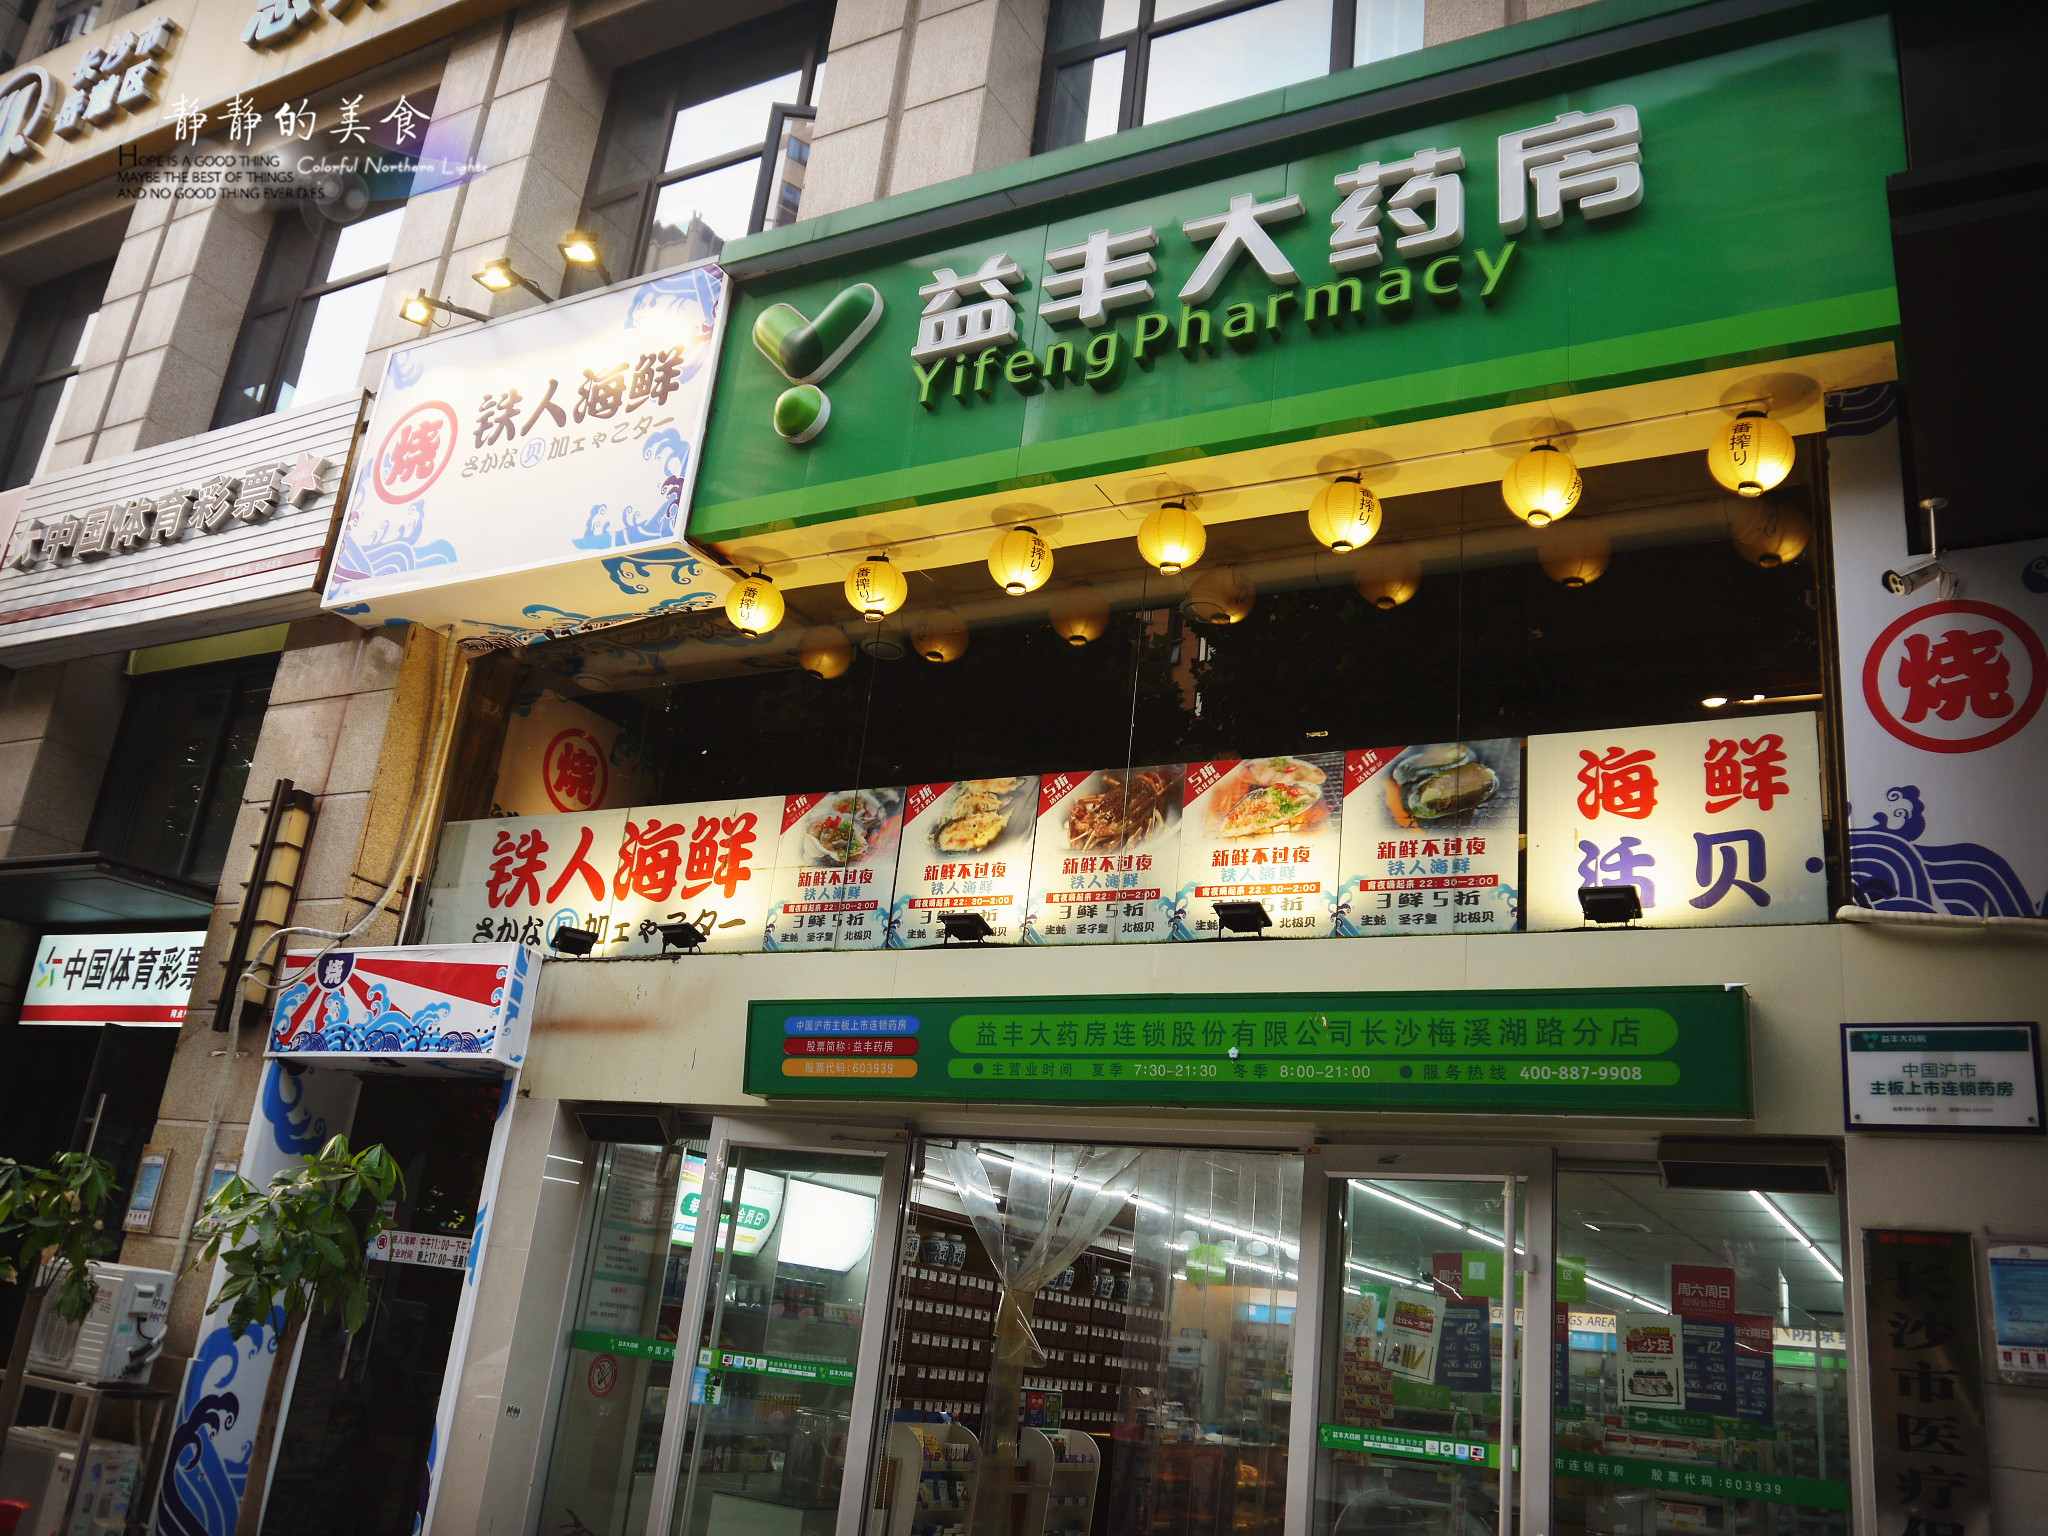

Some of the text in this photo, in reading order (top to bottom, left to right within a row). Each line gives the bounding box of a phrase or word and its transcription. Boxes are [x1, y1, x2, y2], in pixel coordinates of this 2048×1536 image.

[73, 16, 177, 90] 长沙市
[910, 104, 1644, 365] 益丰大药房
[472, 345, 685, 449] 铁人海鲜
[386, 417, 445, 487] 烧
[42, 463, 287, 566] 中国体育彩票
[1898, 629, 2015, 723] 烧
[552, 742, 598, 806] 烧
[1188, 762, 1216, 786] 5折
[1577, 734, 1790, 820] 海鲜
[1042, 773, 1069, 798] 5折
[1212, 846, 1311, 868] 新鲜不过夜
[1377, 836, 1486, 860] 新鲜不过夜
[486, 812, 758, 909] 铁人海鲜
[1063, 854, 1153, 875] 新鲜不过夜
[1387, 858, 1471, 876] 铁人海鲜
[1577, 829, 1772, 910] 活贝
[798, 869, 874, 888] 新鲜不过夜
[924, 862, 1006, 881] 新鲜不过夜
[1071, 873, 1138, 889] 铁人海鲜
[1221, 866, 1295, 882] 铁人海鲜
[804, 886, 861, 901] 铁人海鲜
[931, 880, 992, 895] 铁人海鲜
[1377, 890, 1480, 909] 3鲜5折
[920, 909, 998, 925] 3折
[1059, 903, 1144, 920] 3鲜5折
[1360, 914, 1387, 926] 生蚝
[1454, 911, 1494, 924] 北极贝
[1122, 921, 1154, 932] 北极贝
[1280, 916, 1315, 929] 北极贝
[844, 930, 872, 941] 北极贝
[795, 1019, 907, 1032] 中国沪市主板上市连锁药房
[975, 1015, 1641, 1049] 益丰大药房连锁股份有限公司长沙梅溪湖路分店
[805, 1040, 894, 1053] 股票简称:益丰药房
[1881, 1034, 1927, 1043] 益丰大药房
[804, 1062, 894, 1075] 股票代码:603939
[992, 1062, 1643, 1081] 主营业时间 夏季 7:30-21:30 冬季 8:00-21:00 服务热线 400-887-9908
[1902, 1062, 1977, 1079] 中国沪市
[1870, 1080, 2015, 1098] 主板上市连锁药房
[1678, 1282, 1731, 1299] 周六周日
[1586, 1315, 1616, 1328] AREA
[1651, 1468, 1783, 1495] 股票代码:603939
